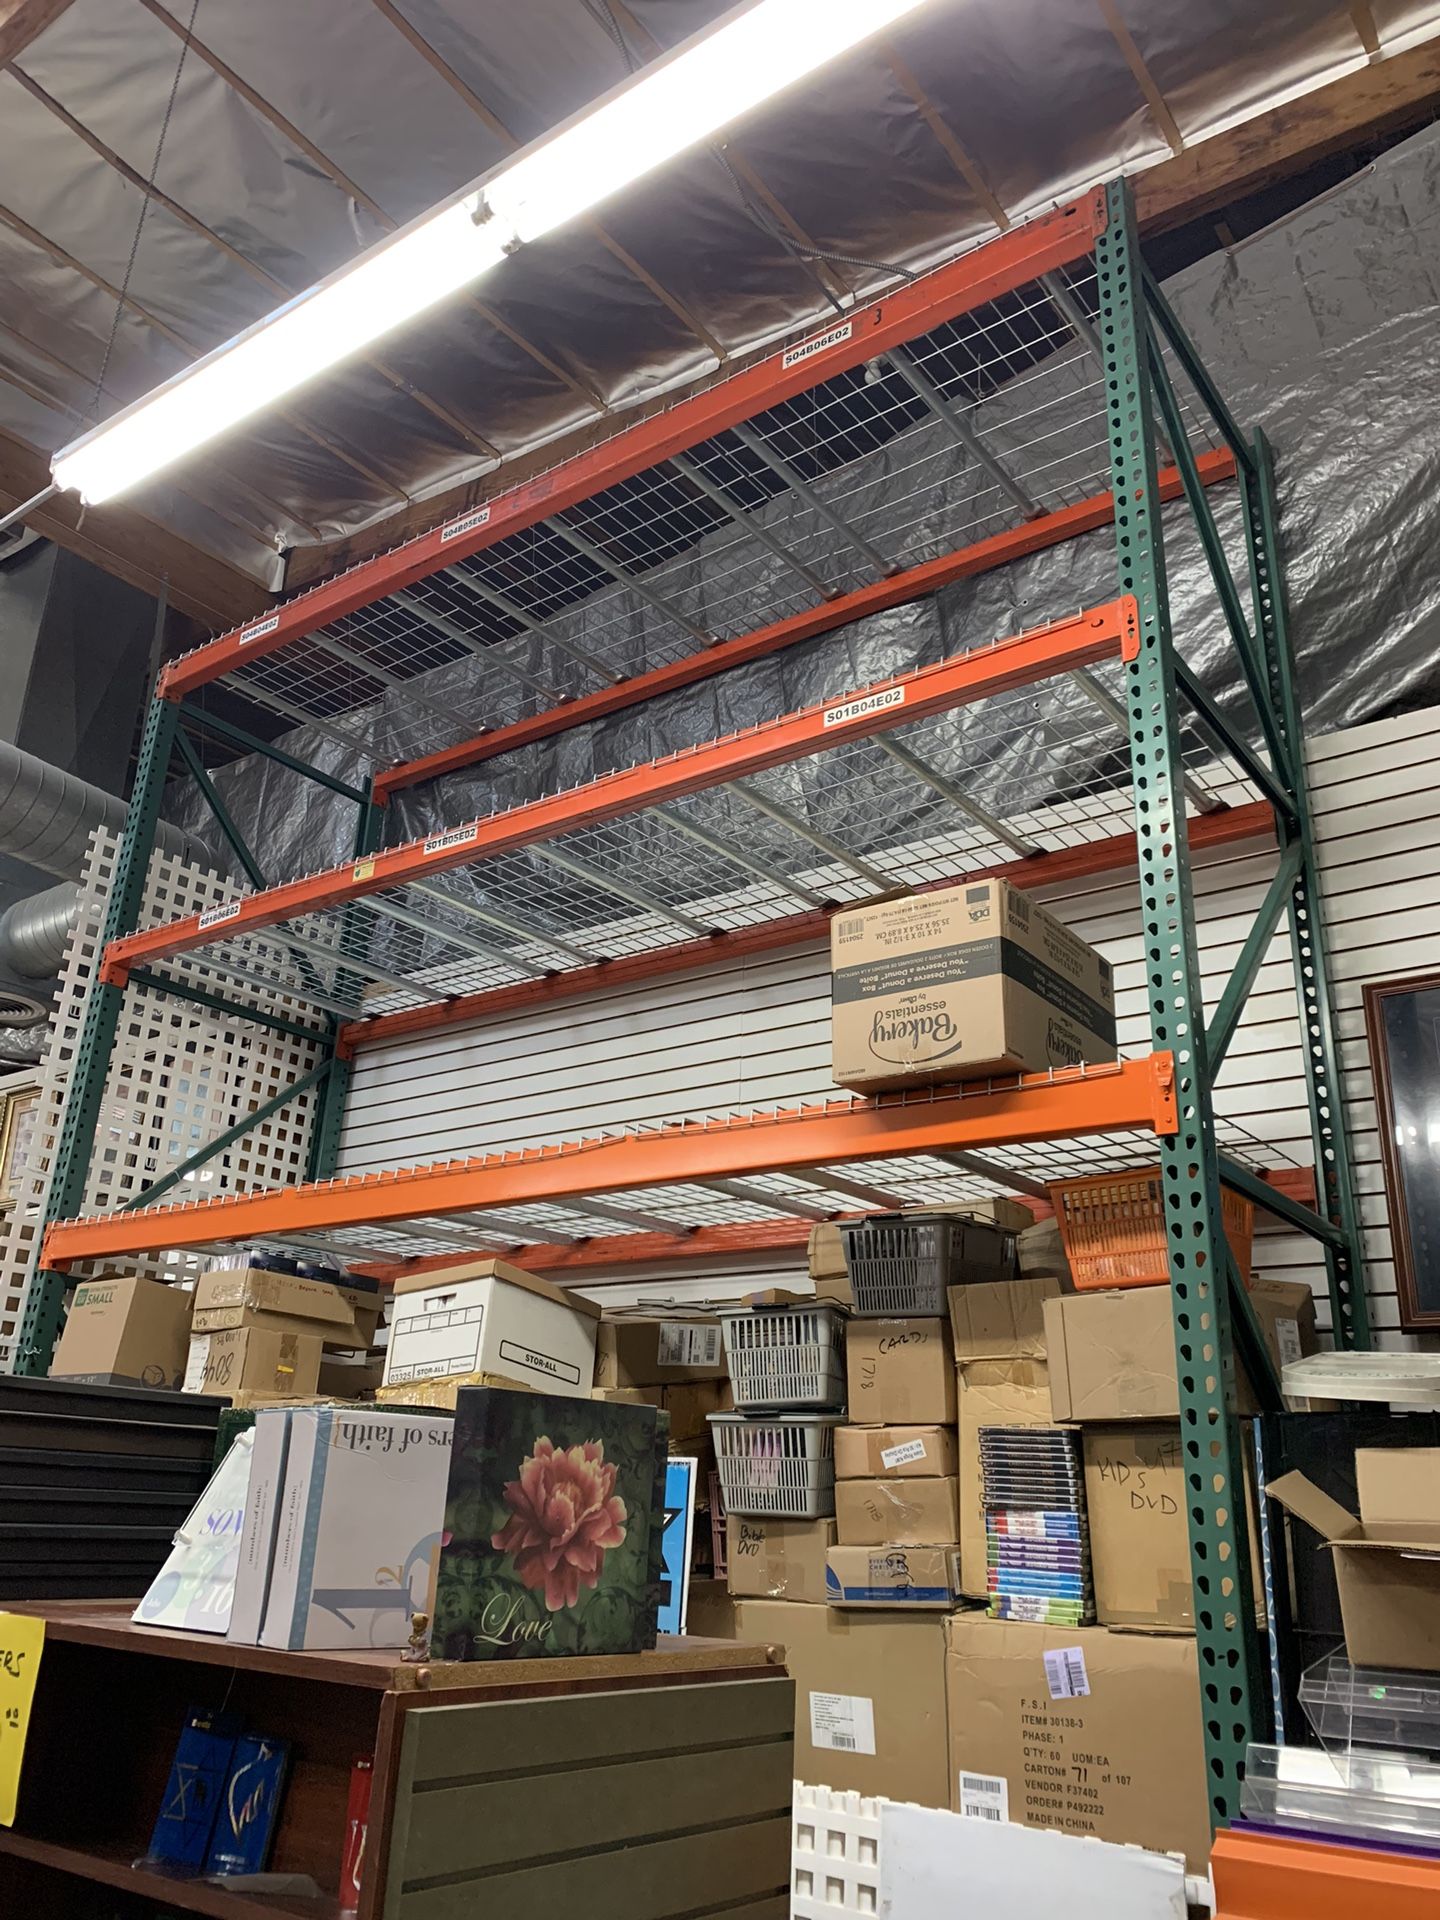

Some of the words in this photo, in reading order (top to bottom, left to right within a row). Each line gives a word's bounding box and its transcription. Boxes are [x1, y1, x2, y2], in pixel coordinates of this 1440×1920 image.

[785, 327, 849, 364] S04B06E02
[827, 690, 901, 723] S01B04E02
[425, 828, 476, 851] S01B05E02
[913, 971, 946, 982] Deserve
[916, 961, 948, 972] Deserve
[885, 1000, 947, 1020] essentials
[873, 1010, 957, 1049] Bakery
[87, 1292, 113, 1305] SMALL
[416, 1366, 445, 1376] STOR-ALL
[525, 1353, 557, 1372] STOR-ALL
[398, 1428, 422, 1454] of
[1130, 1490, 1178, 1515] DVD
[737, 1540, 760, 1557] DVD
[473, 1592, 553, 1646] Love
[1021, 1714, 1047, 1726] ITEM#
[1050, 1717, 1084, 1729] 30138-3
[1022, 1730, 1056, 1744] PHASE:
[1059, 1735, 1064, 1744] 1
[1023, 1746, 1047, 1759] Q'TY:
[1050, 1751, 1061, 1761] 60
[1024, 1763, 1066, 1777] CARTON#
[1071, 1766, 1088, 1783] 71
[1101, 1774, 1111, 1783] of
[1116, 1775, 1132, 1786] 107
[1025, 1779, 1063, 1793] VENDOR
[1067, 1785, 1099, 1799] F37402
[1026, 1795, 1063, 1809] ORDER#
[1067, 1801, 1105, 1816] P492222
[1027, 1812, 1052, 1825] MADE
[1055, 1817, 1064, 1827] IN
[1065, 1818, 1096, 1832] CHINA
